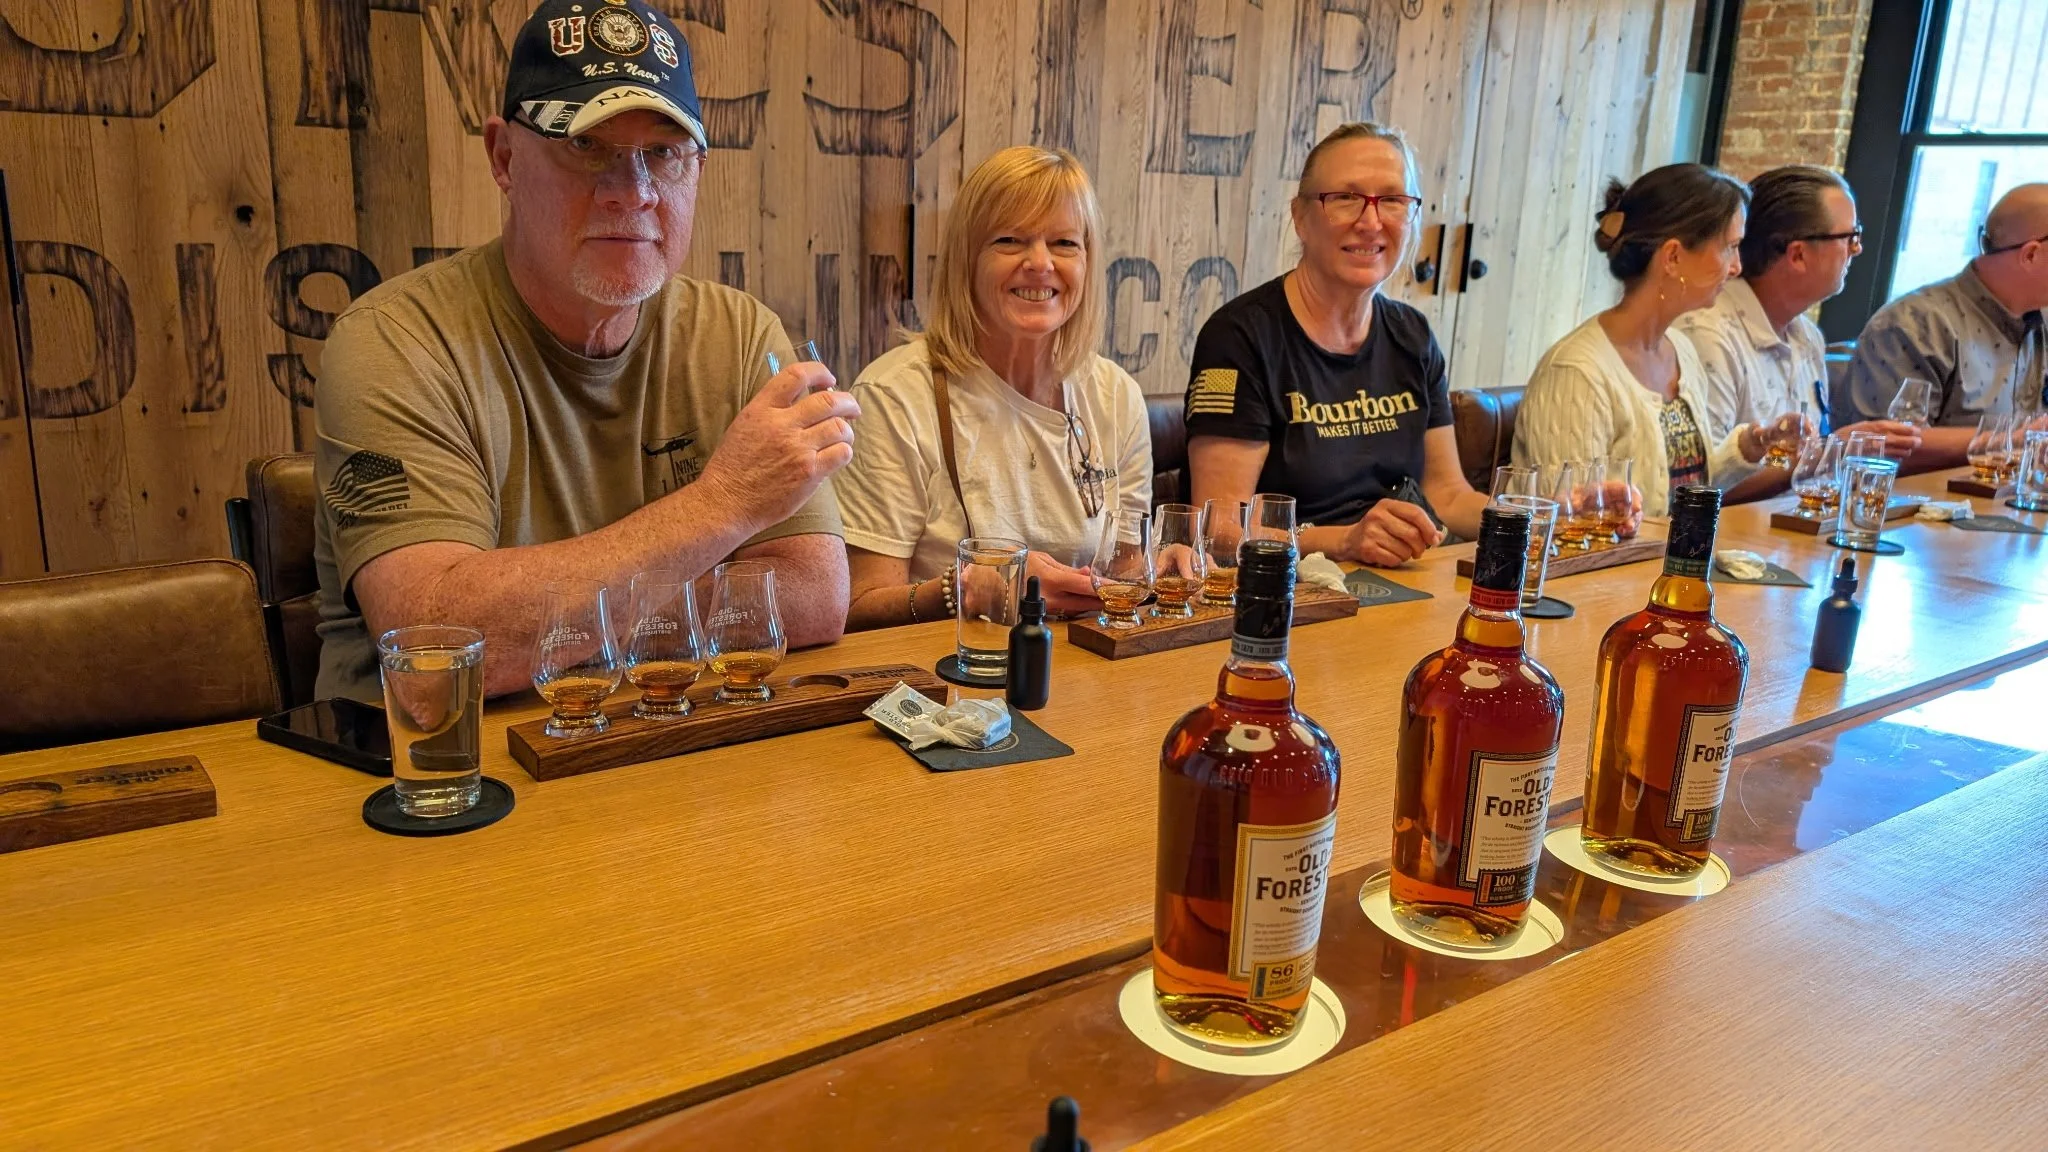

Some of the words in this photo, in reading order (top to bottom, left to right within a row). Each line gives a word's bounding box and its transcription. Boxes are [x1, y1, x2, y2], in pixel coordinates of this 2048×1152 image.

[593, 9, 611, 36] UNITED
[548, 16, 586, 57] U
[649, 23, 678, 69] S
[582, 61, 619, 77] U.S.
[623, 62, 660, 84] Navy
[1285, 389, 1419, 425] Bourbon
[1317, 425, 1350, 438] MAKES
[1351, 422, 1361, 436] IT
[1362, 418, 1399, 435] BETTER
[675, 456, 699, 475] NINE
[1523, 776, 1550, 796] OLD
[1299, 848, 1328, 874] OLD
[1493, 874, 1516, 887] 100
[1493, 885, 1514, 893] PROOF
[1269, 975, 1293, 987] PROOF
[1270, 963, 1294, 979] 86
